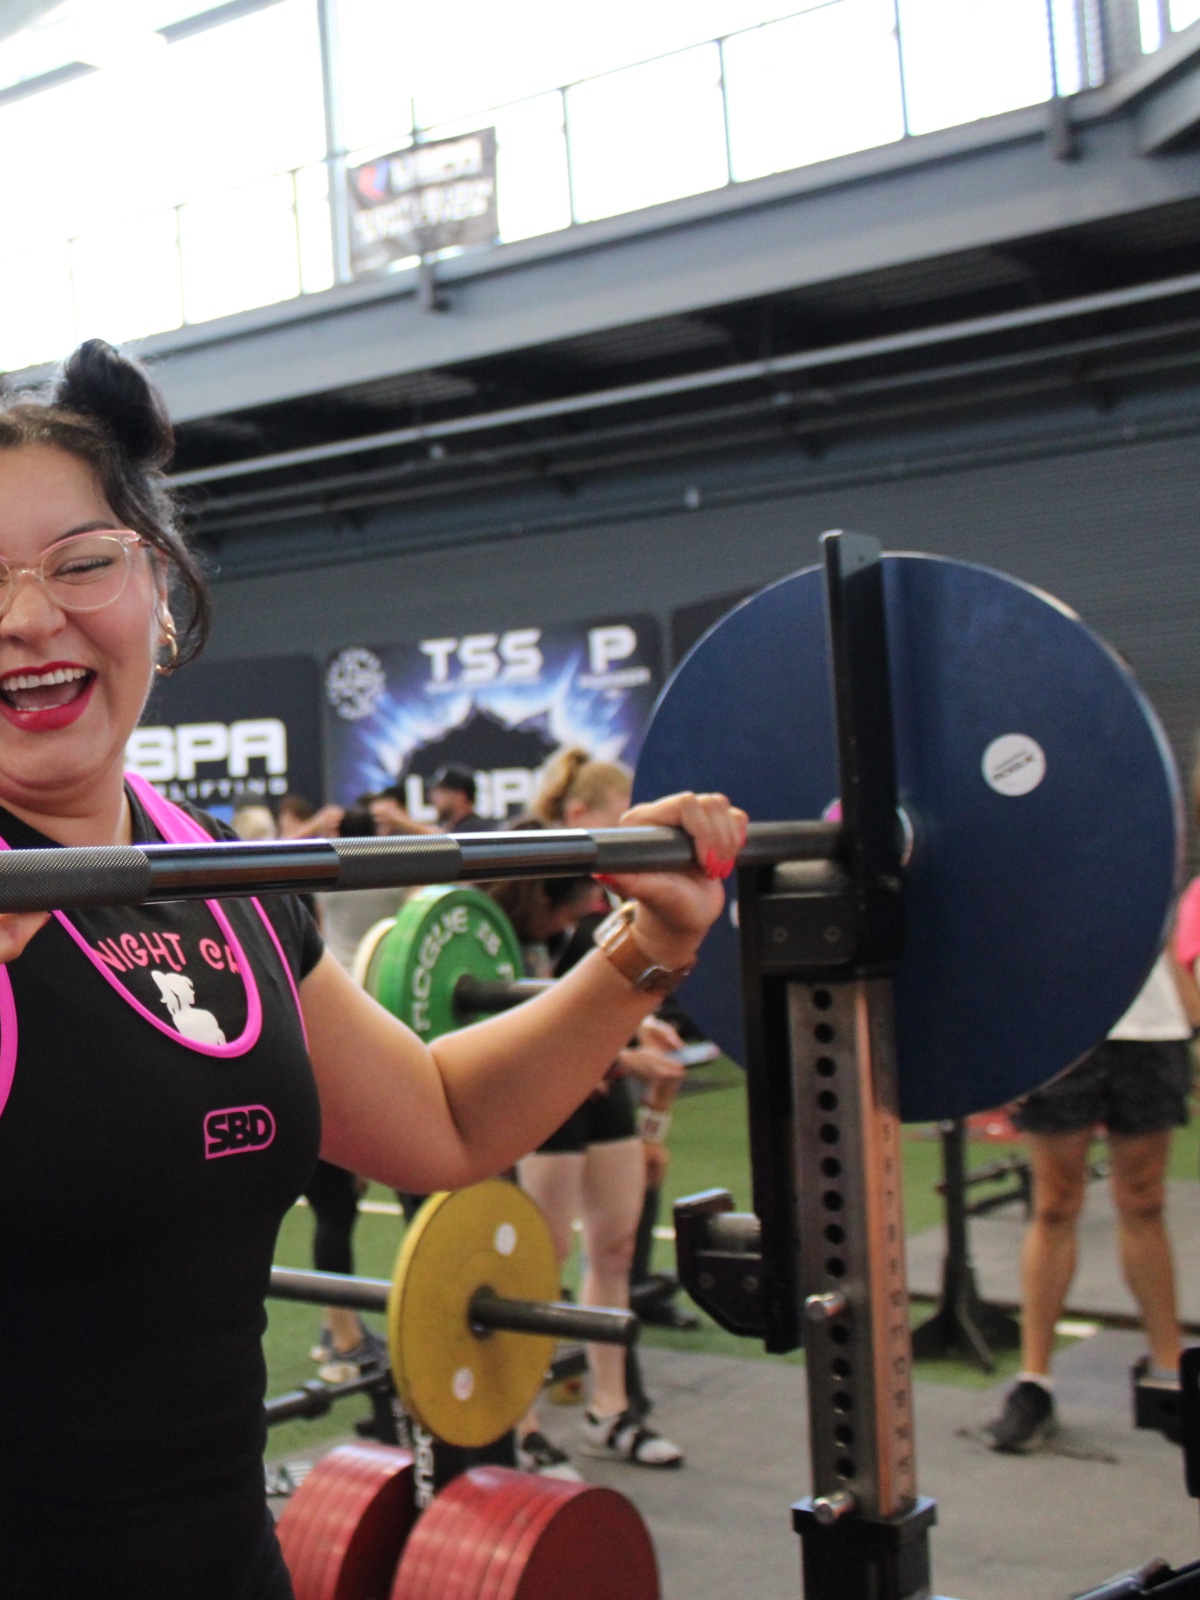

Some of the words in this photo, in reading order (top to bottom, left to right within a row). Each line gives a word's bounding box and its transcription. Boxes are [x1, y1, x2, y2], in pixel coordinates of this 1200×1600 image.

[418, 628, 544, 684] TSS
[588, 624, 638, 674] P
[125, 718, 288, 782] SPA
[89, 931, 187, 973] NIGHT
[205, 1107, 274, 1154] SBD
